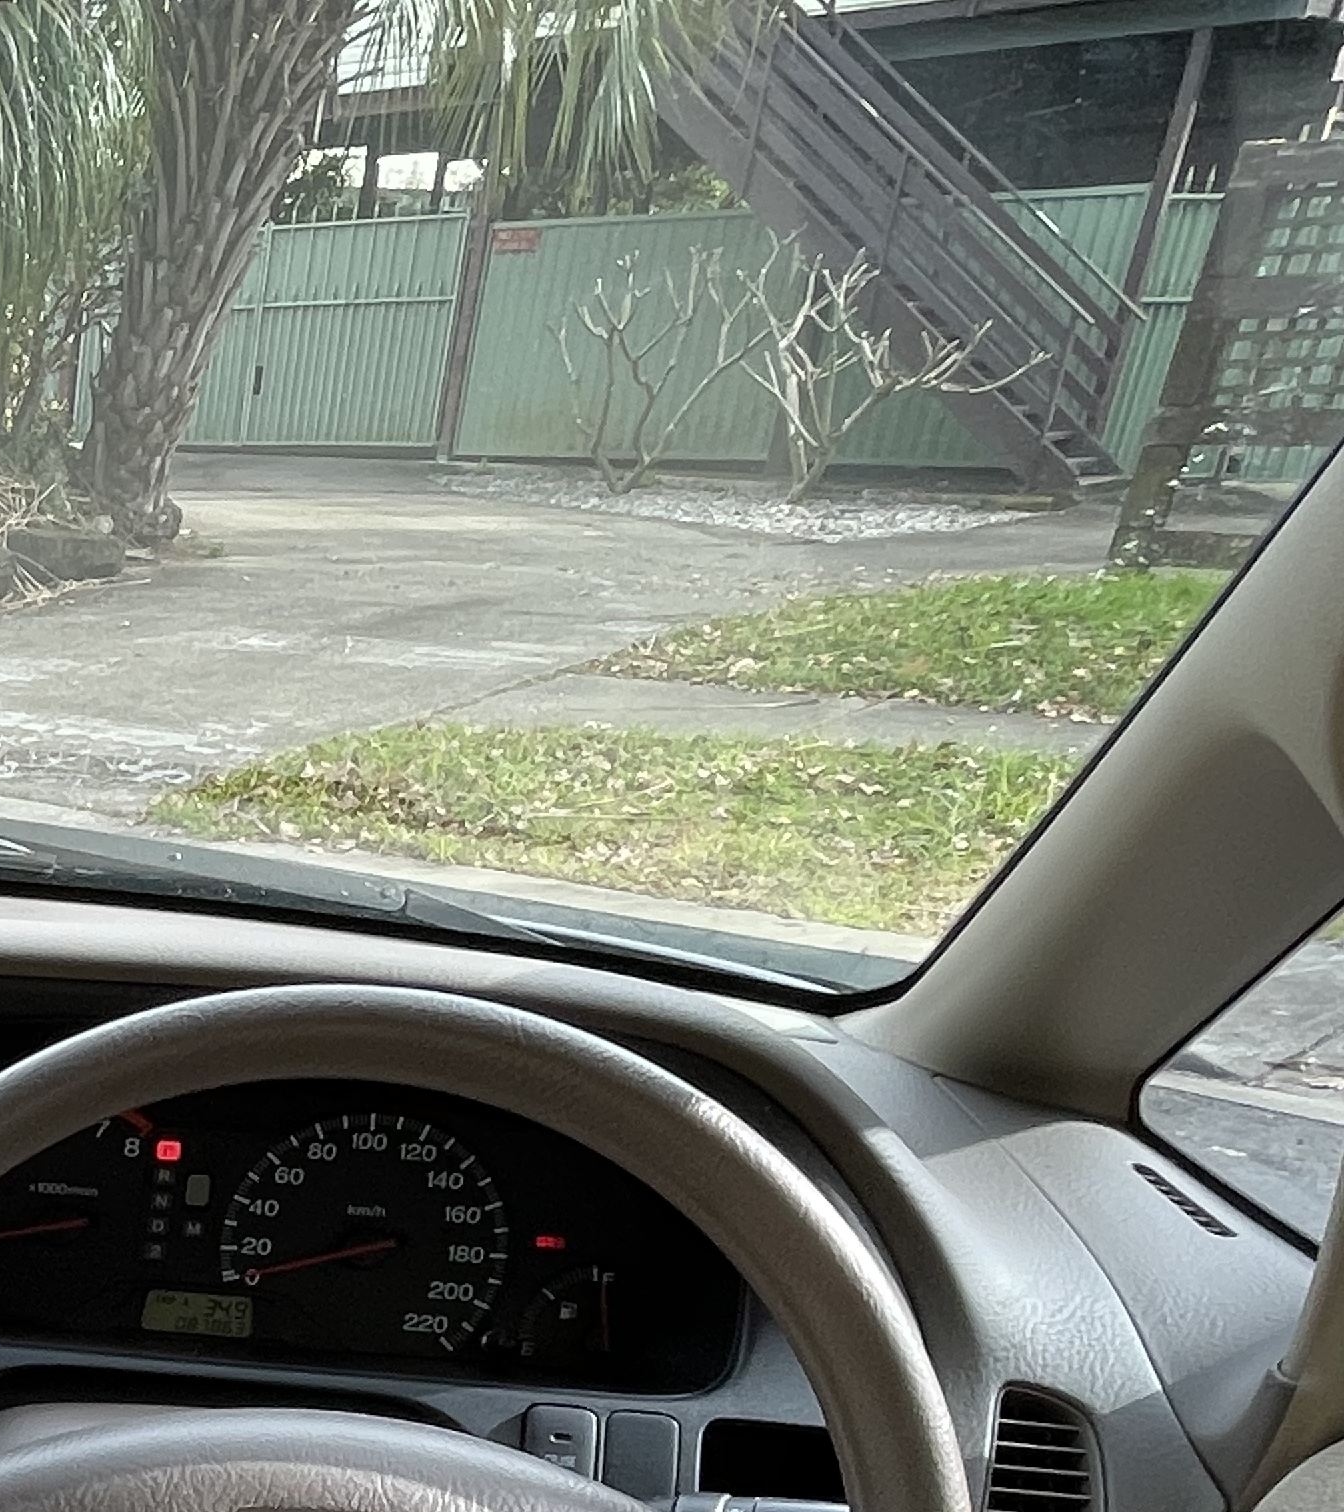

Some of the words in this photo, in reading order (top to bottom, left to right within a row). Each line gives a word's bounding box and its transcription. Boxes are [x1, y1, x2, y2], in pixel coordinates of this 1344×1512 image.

[124, 1137, 140, 1157] 8
[352, 1132, 388, 1151] 100
[307, 1143, 338, 1161] 80
[400, 1143, 437, 1162] 120
[274, 1167, 305, 1185] 60
[427, 1171, 464, 1190] 140
[248, 1199, 280, 1217] 40
[347, 1204, 386, 1218] km/h
[445, 1206, 482, 1224] 160
[240, 1238, 272, 1255] 20
[448, 1245, 485, 1263] 180
[244, 1267, 260, 1285] 0
[427, 1281, 474, 1301] 200
[402, 1313, 448, 1333] 220
